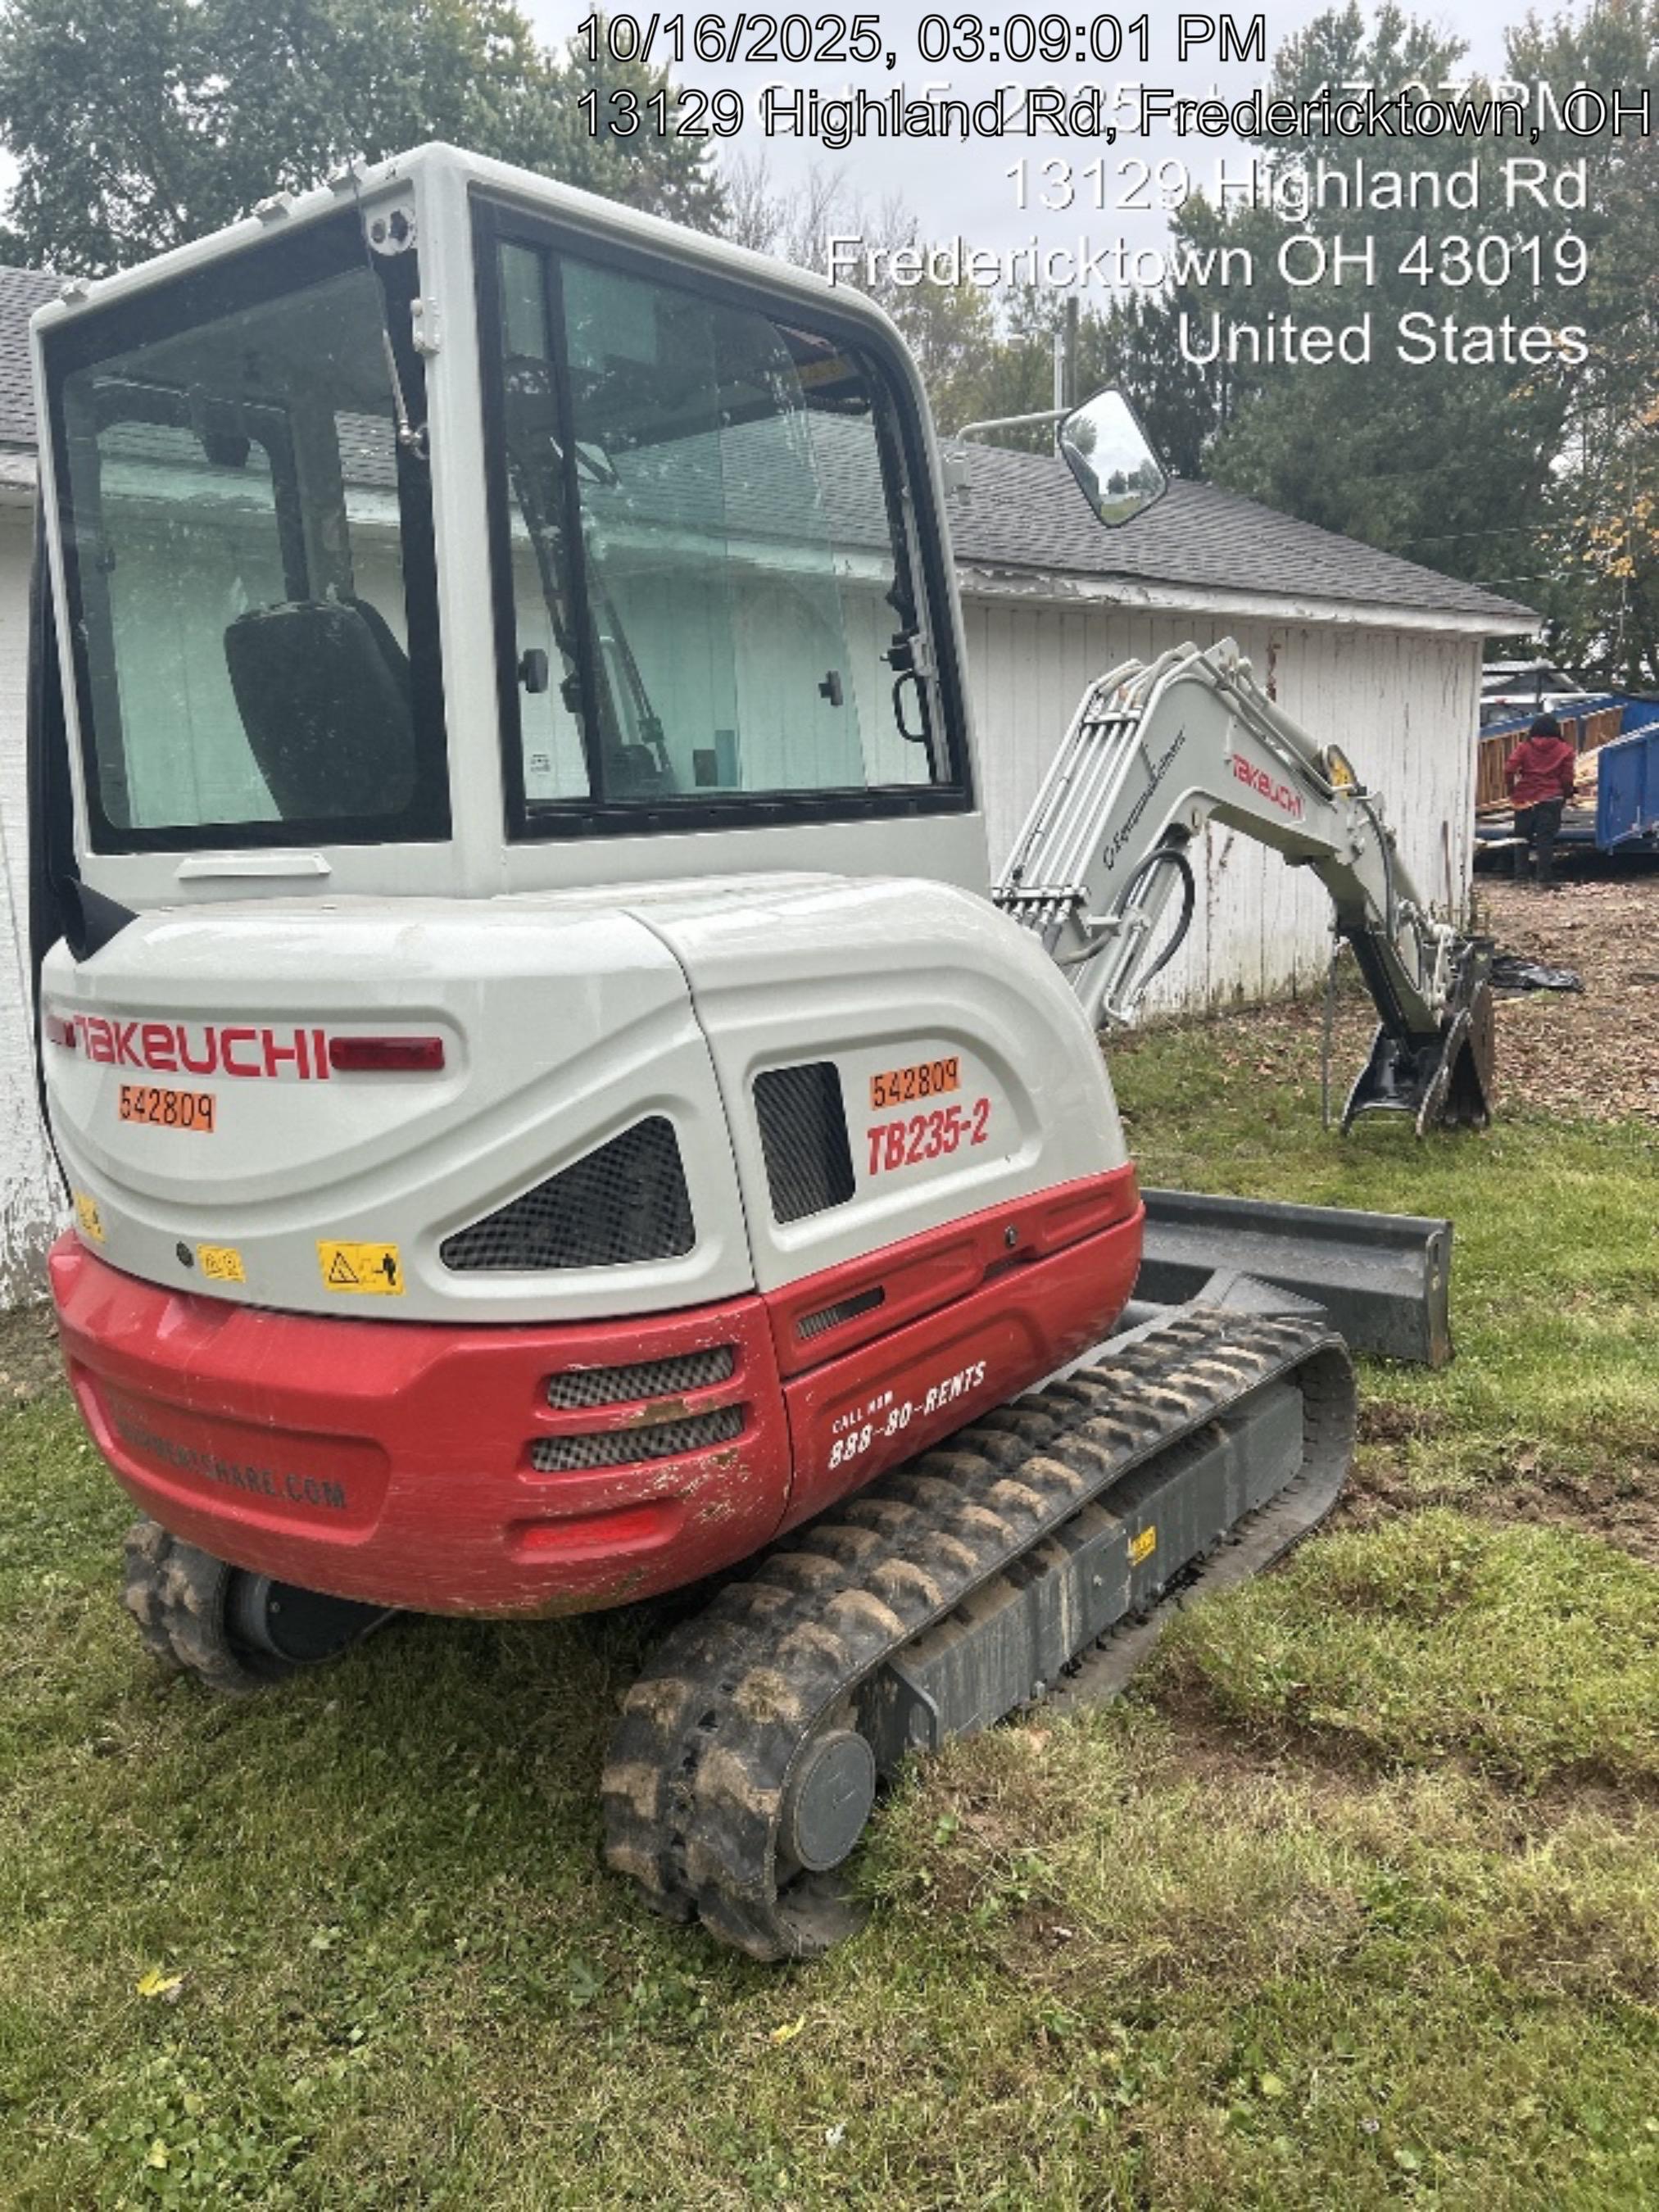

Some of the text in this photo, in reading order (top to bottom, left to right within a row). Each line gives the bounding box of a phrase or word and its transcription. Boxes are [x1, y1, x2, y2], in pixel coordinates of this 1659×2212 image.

[120, 1085, 214, 1130] 542809
[873, 1058, 958, 1108] 542809
[867, 1098, 990, 1176] TB235-2
[827, 1360, 987, 1471] 888-80-RENTS
[832, 1407, 863, 1434] CALL
